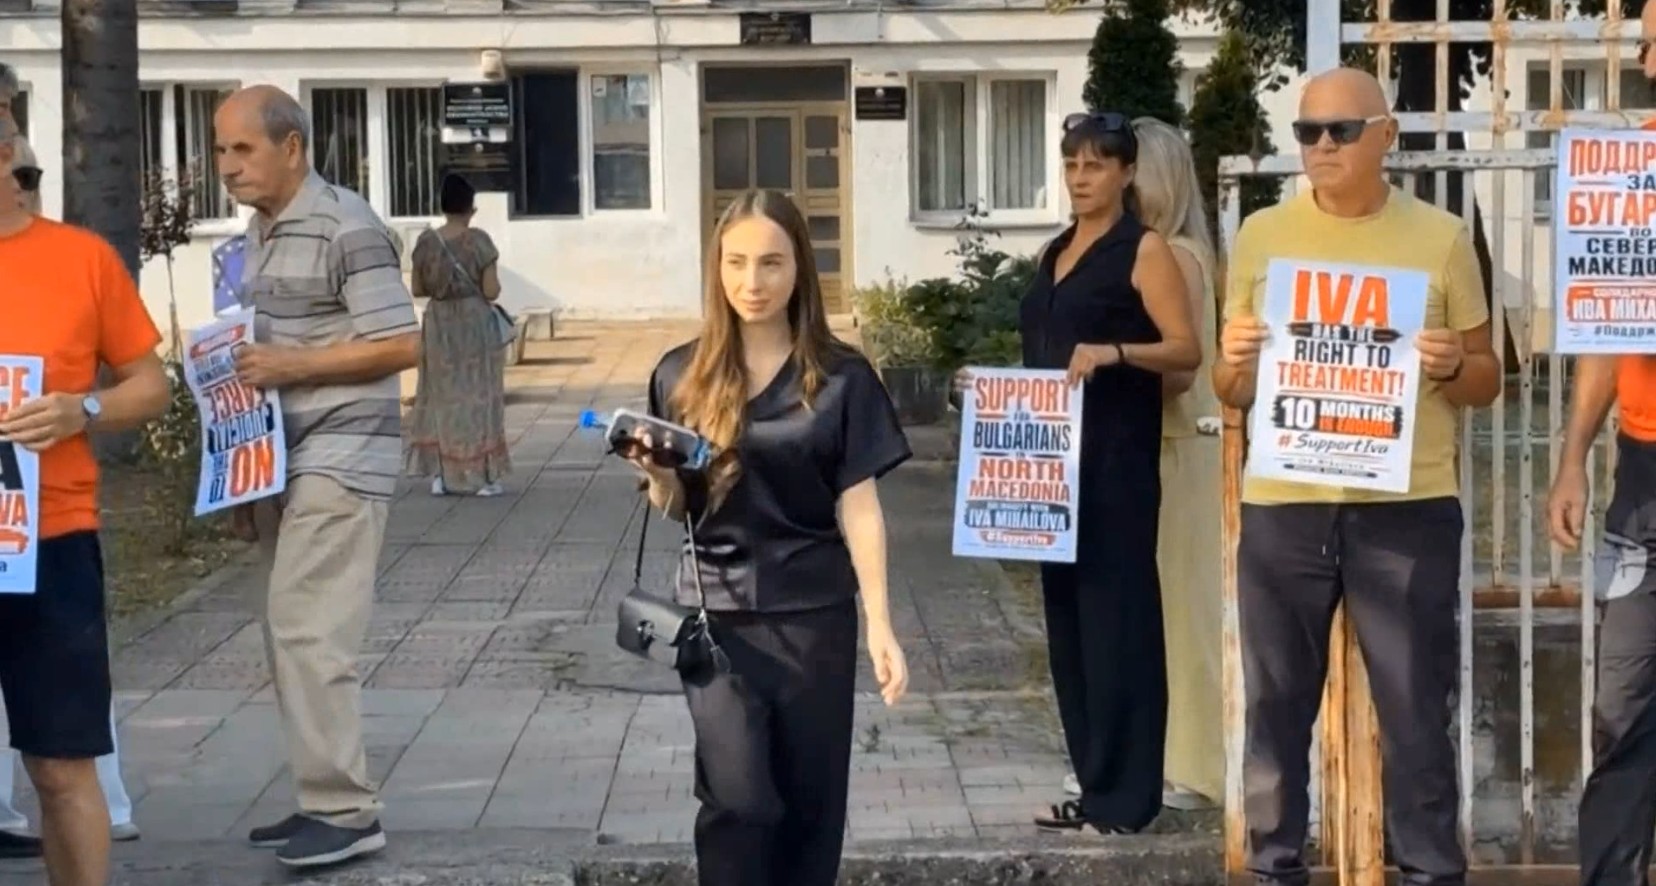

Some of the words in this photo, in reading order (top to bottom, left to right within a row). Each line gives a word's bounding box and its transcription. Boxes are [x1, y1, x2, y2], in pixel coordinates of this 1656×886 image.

[1569, 140, 1656, 176] ПОДДР
[1627, 174, 1656, 190] ЗА
[1568, 191, 1656, 227] БУГАР
[1587, 238, 1656, 255] СЕВЕР
[1294, 270, 1389, 328] IVA
[1573, 299, 1606, 320] ИВА
[1294, 340, 1358, 366] RIGHT
[1366, 344, 1391, 368] TO
[1277, 362, 1406, 396] TREATMENT!
[975, 377, 1070, 413] SUPPORT
[1280, 398, 1316, 429] 10
[1320, 401, 1395, 423] MONTHS
[973, 422, 1072, 451] BULGARIANS
[229, 435, 275, 497] NO
[979, 459, 1064, 481] NORTH
[969, 480, 1071, 502] MACEDONIA
[969, 509, 992, 527] IVA
[994, 511, 1067, 531] MIHAILOVA
